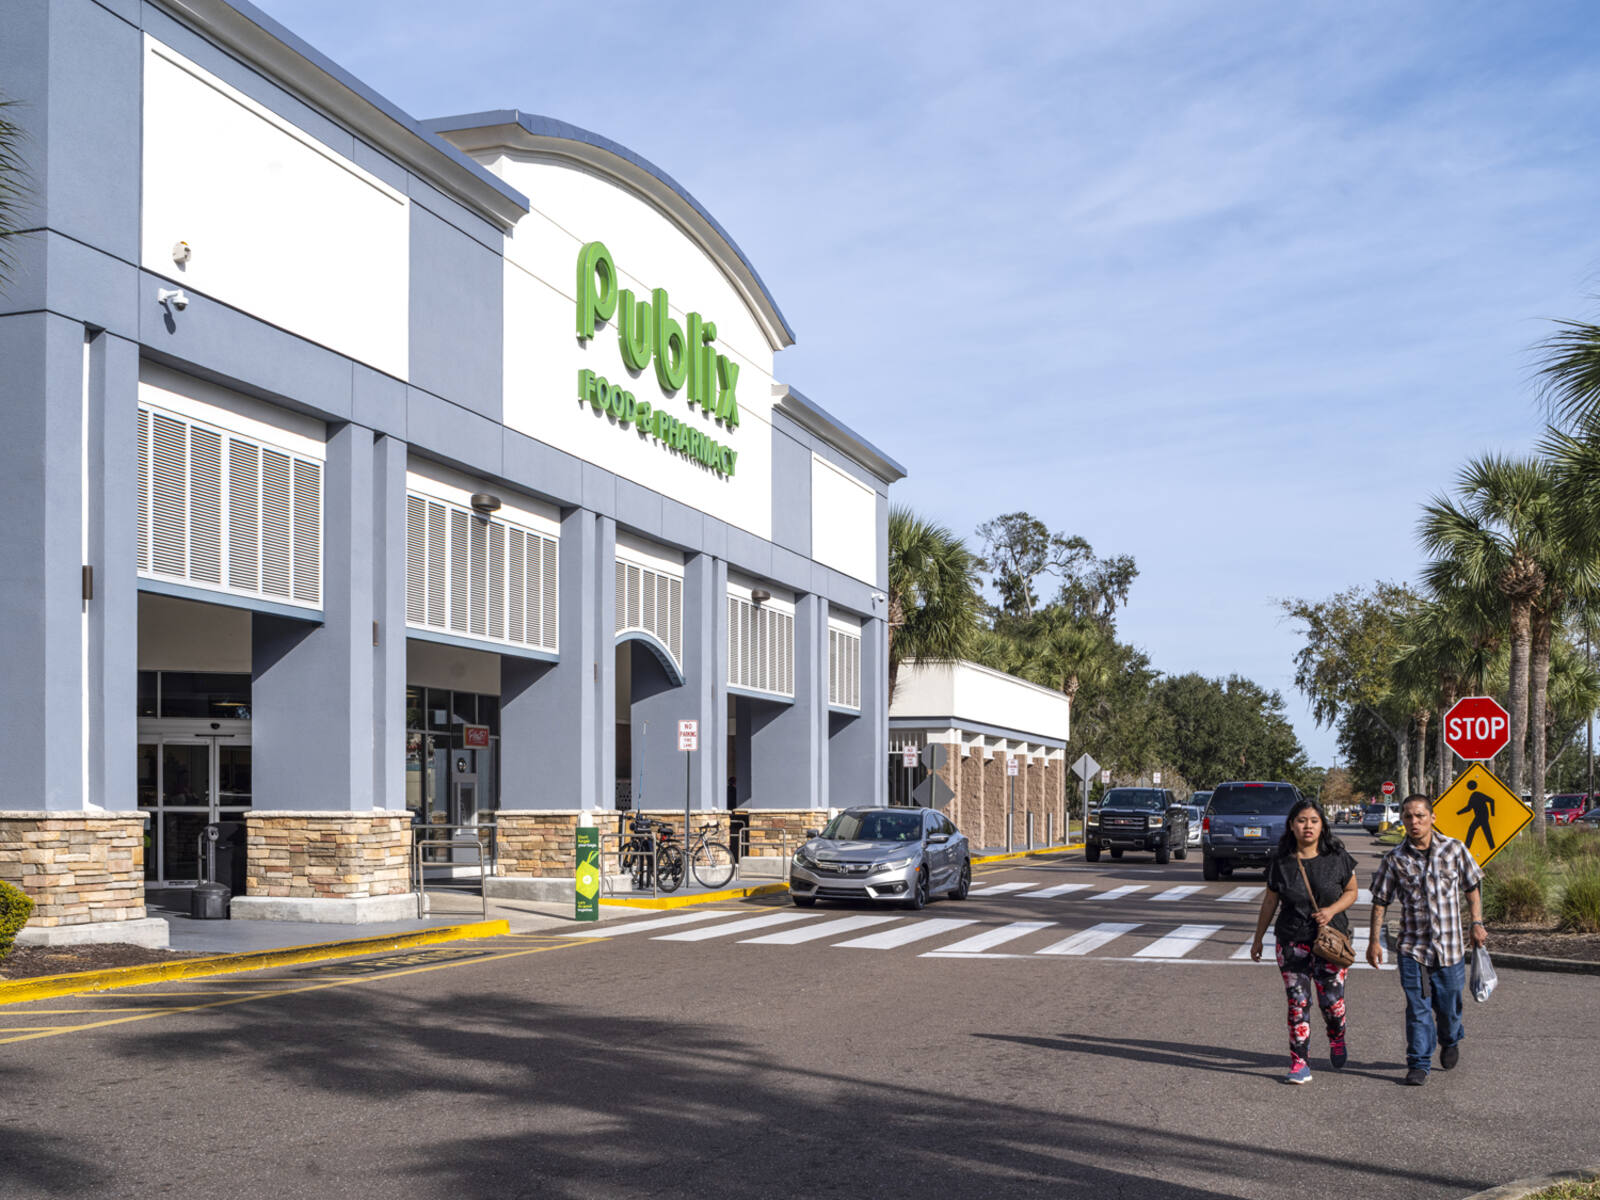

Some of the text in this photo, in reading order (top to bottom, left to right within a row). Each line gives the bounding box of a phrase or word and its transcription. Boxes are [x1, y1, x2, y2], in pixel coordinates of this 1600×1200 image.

[576, 241, 739, 427] Publix
[578, 369, 738, 476] FOOD & PHARMACY
[1448, 716, 1506, 741] STOP
